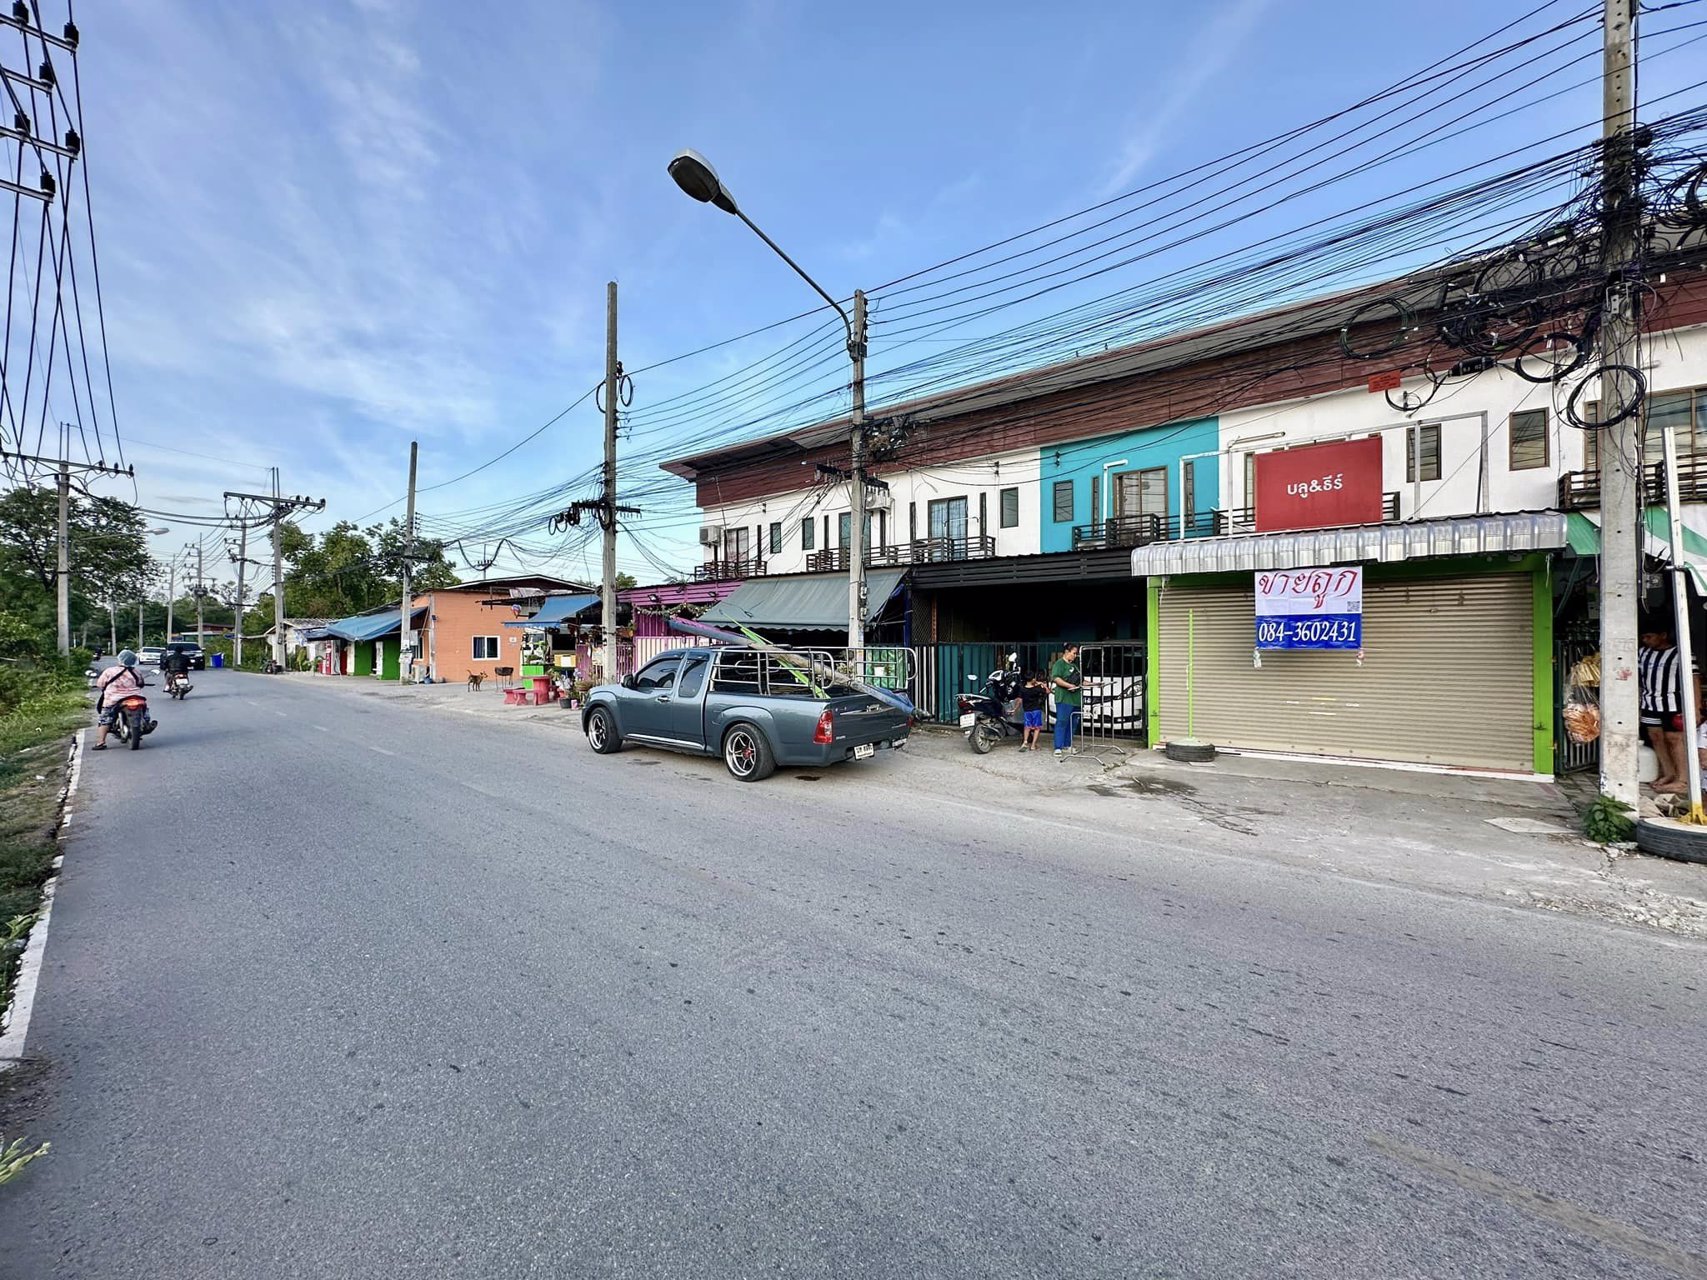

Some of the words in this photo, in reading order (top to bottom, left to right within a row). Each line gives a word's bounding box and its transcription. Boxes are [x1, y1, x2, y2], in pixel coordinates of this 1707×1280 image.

[1287, 473, 1344, 498] บลู&ธีร์
[1258, 569, 1358, 609] ขายถูก
[1258, 621, 1356, 641] 084-3602431
